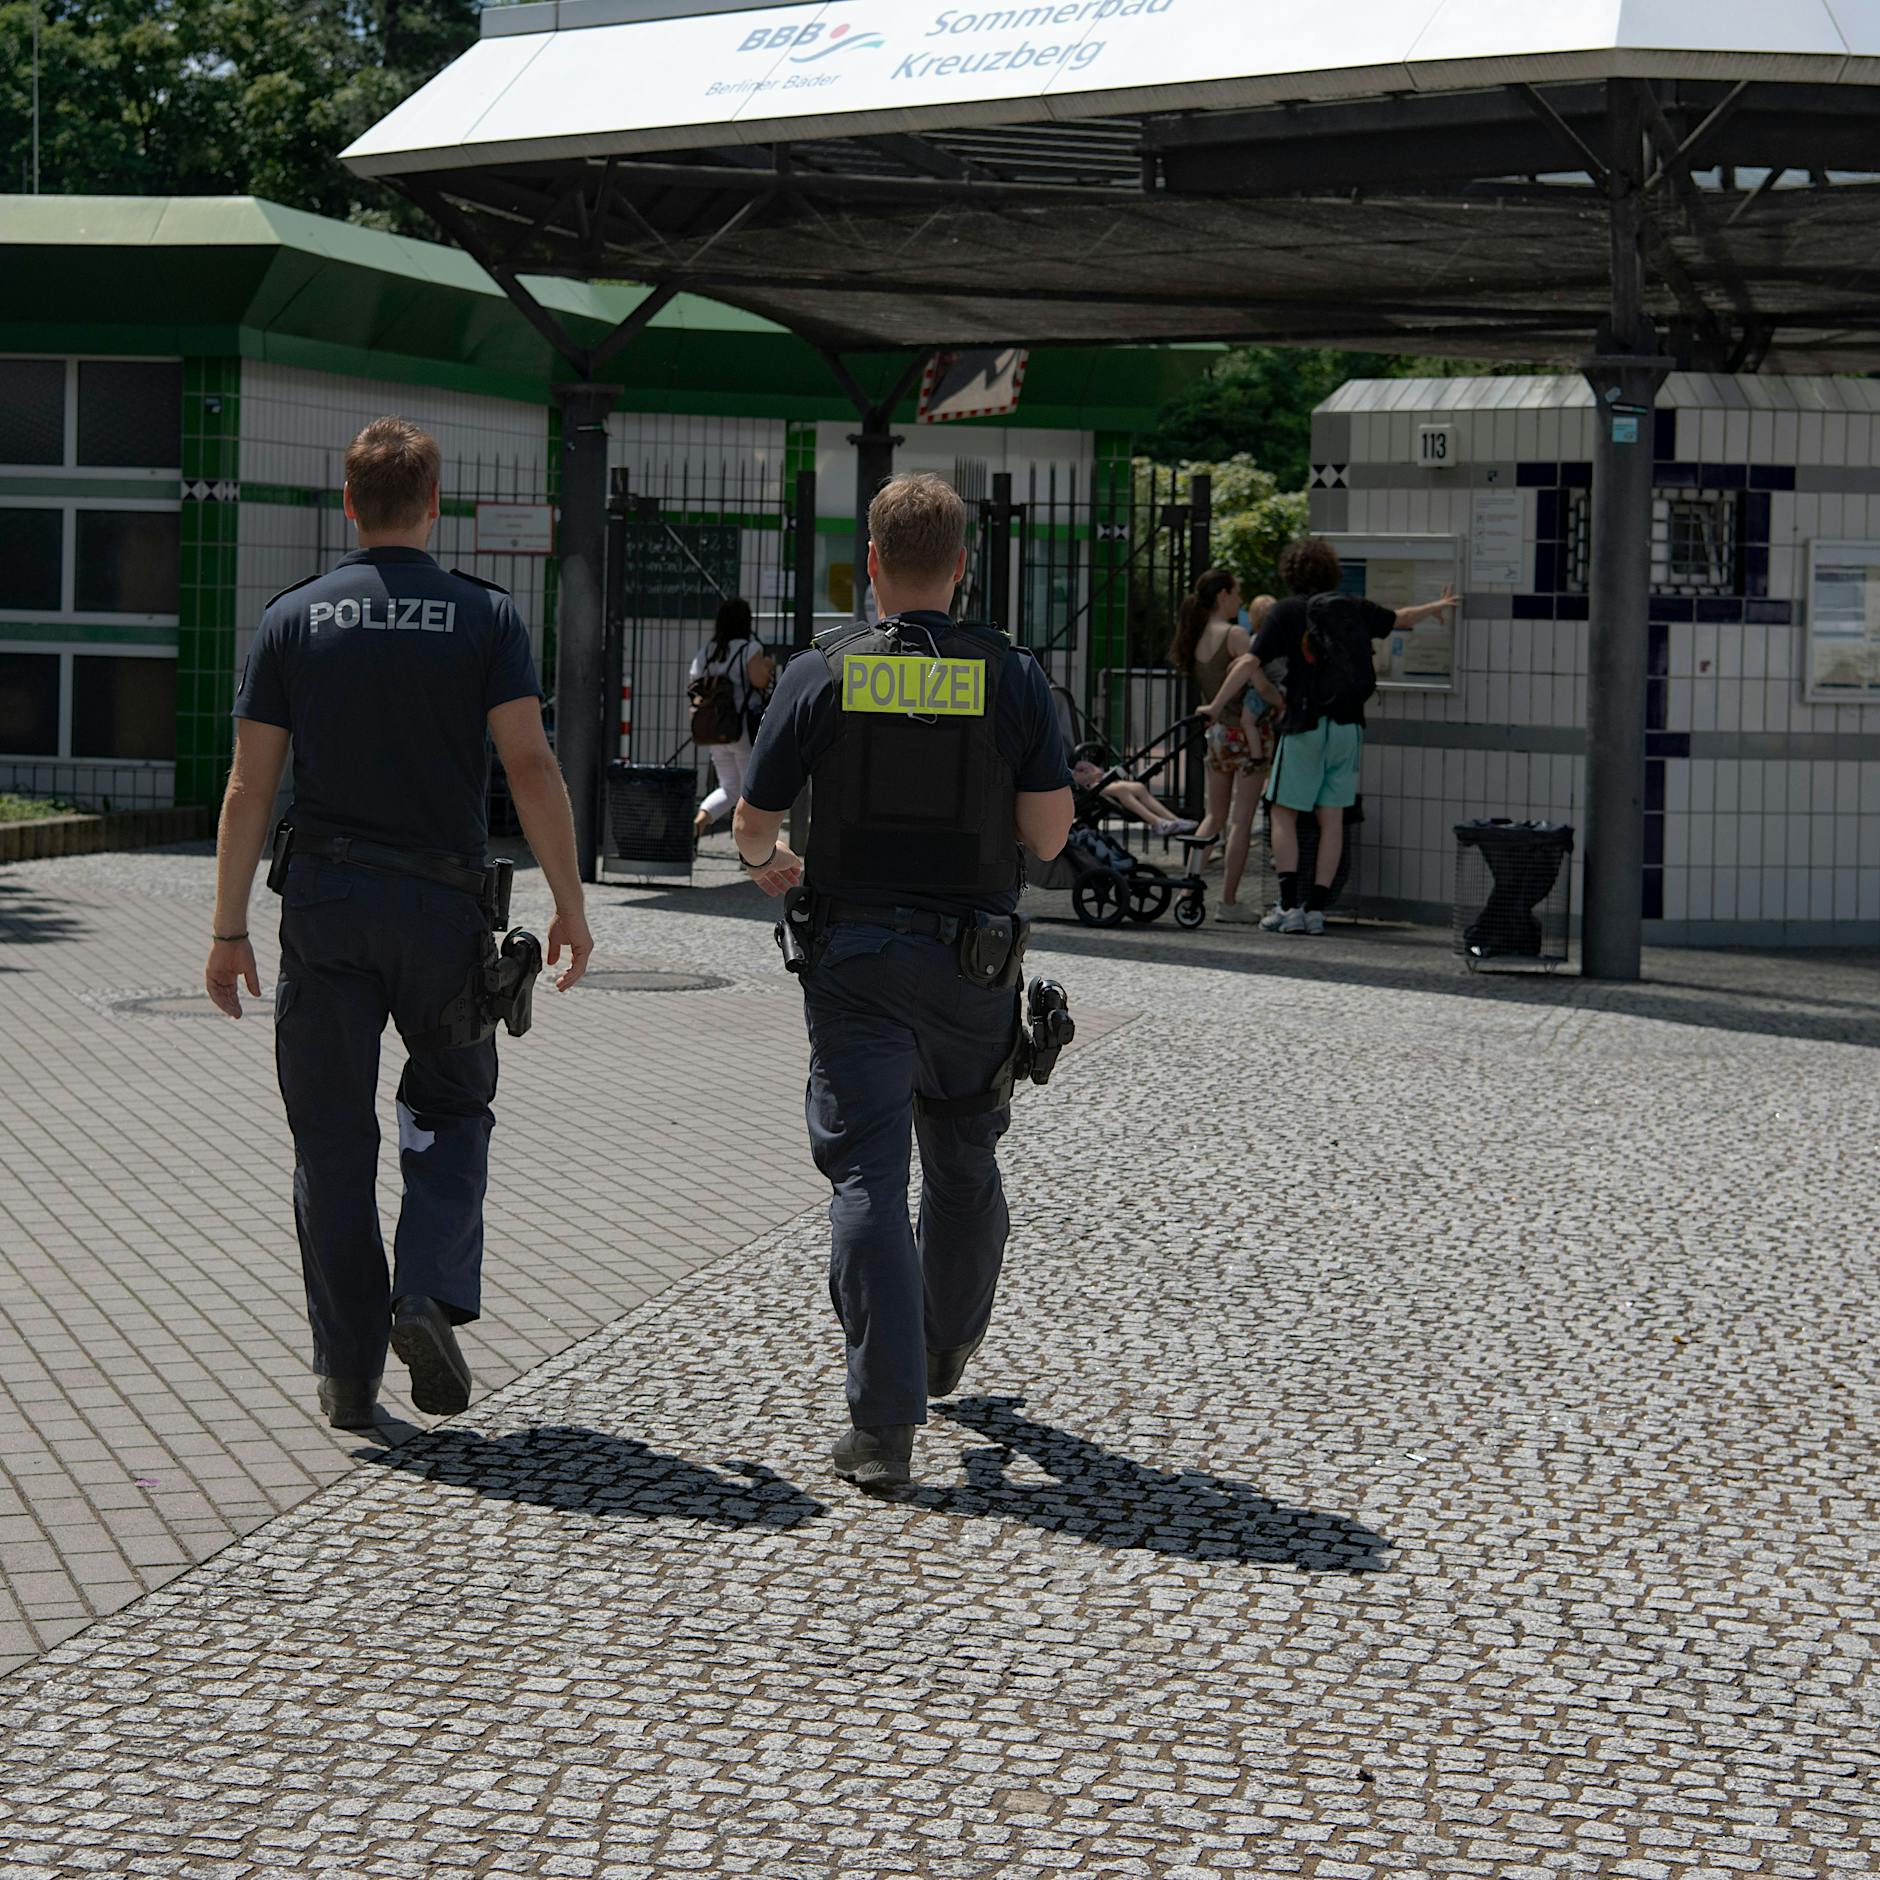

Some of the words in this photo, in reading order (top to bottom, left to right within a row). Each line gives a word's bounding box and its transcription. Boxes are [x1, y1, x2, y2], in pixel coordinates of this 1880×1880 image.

[736, 22, 826, 52] BBB
[890, 39, 1107, 80] Kreuzberg
[704, 78, 781, 96] Berliner
[1421, 432, 1447, 459] 113
[309, 597, 456, 634] POLIZEI
[847, 662, 980, 710] POLIZEI
